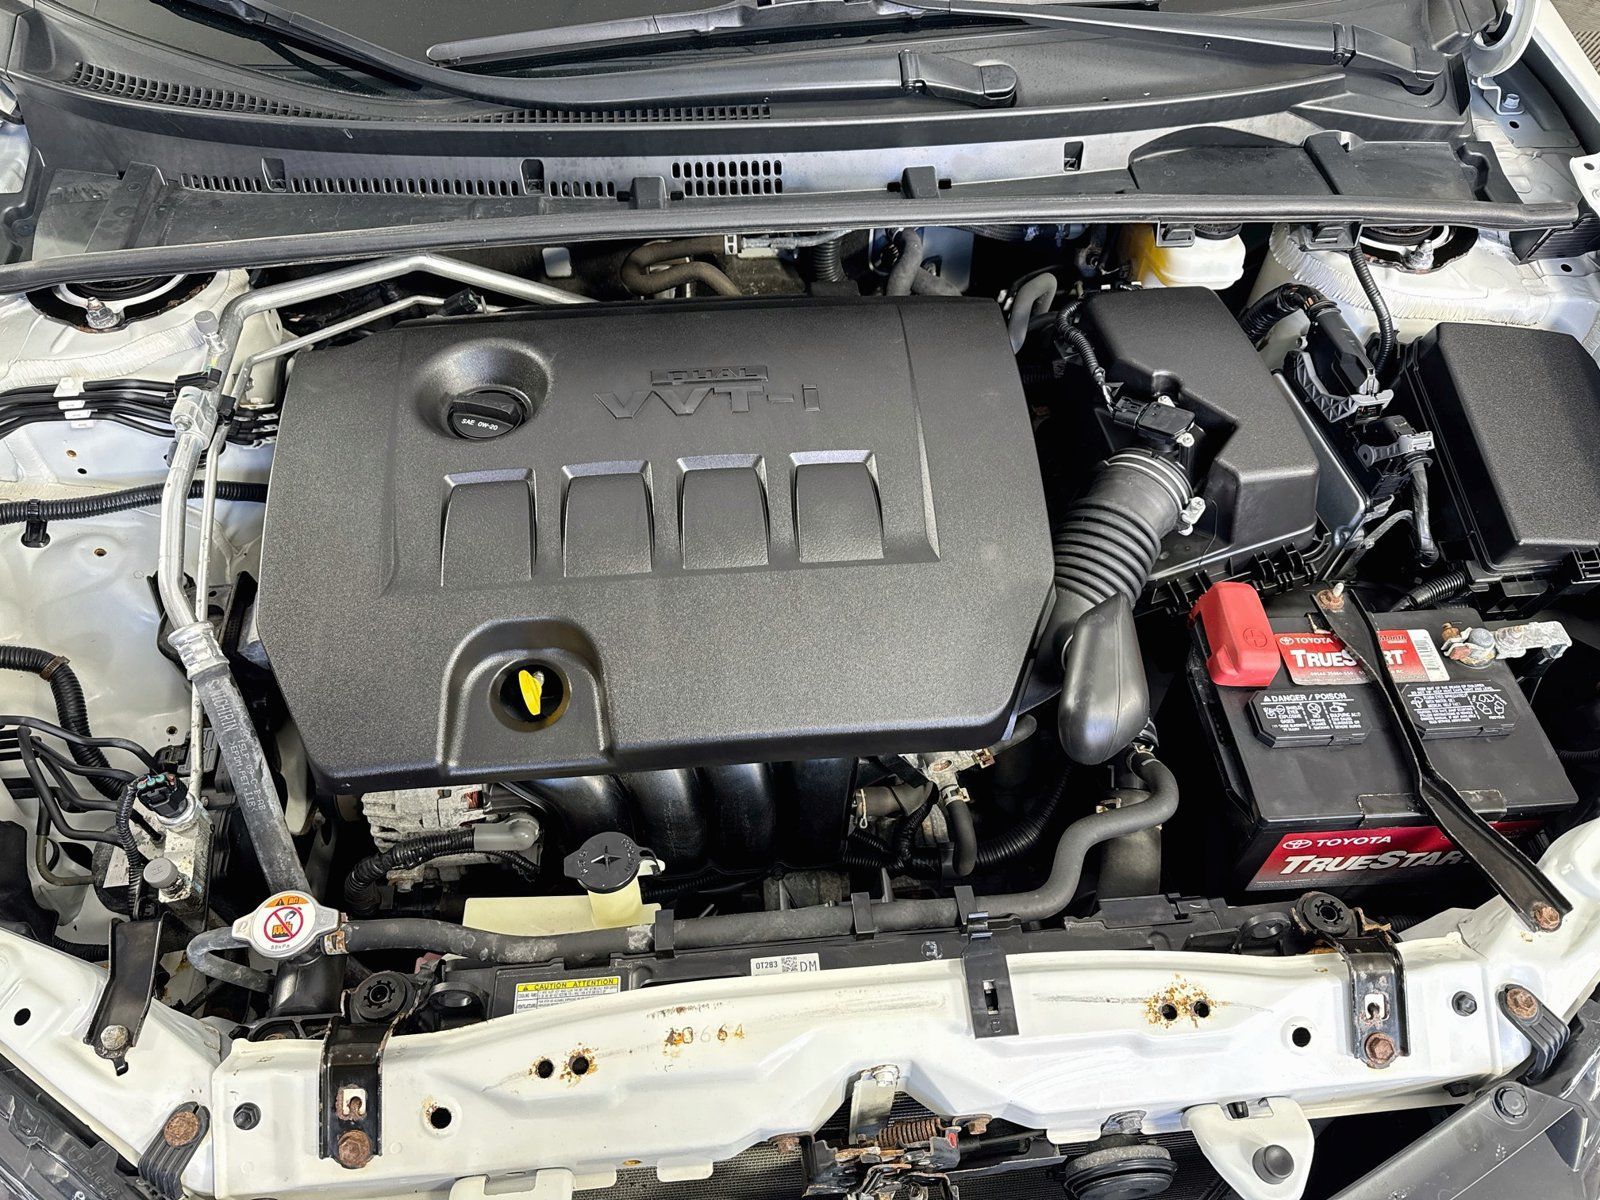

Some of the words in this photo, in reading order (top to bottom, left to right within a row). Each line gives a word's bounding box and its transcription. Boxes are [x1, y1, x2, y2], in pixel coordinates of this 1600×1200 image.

[667, 368, 758, 382] DUAL
[461, 418, 475, 426] SAE
[477, 421, 499, 431] 0W-20
[1271, 694, 1307, 702] DANGER
[1314, 692, 1347, 700] POISON
[1316, 835, 1392, 847] TOYOTA
[1280, 850, 1470, 875] TRUESTAR
[800, 960, 817, 972] DM
[534, 983, 567, 991] CAUTION
[573, 979, 614, 989] ATTENTION
